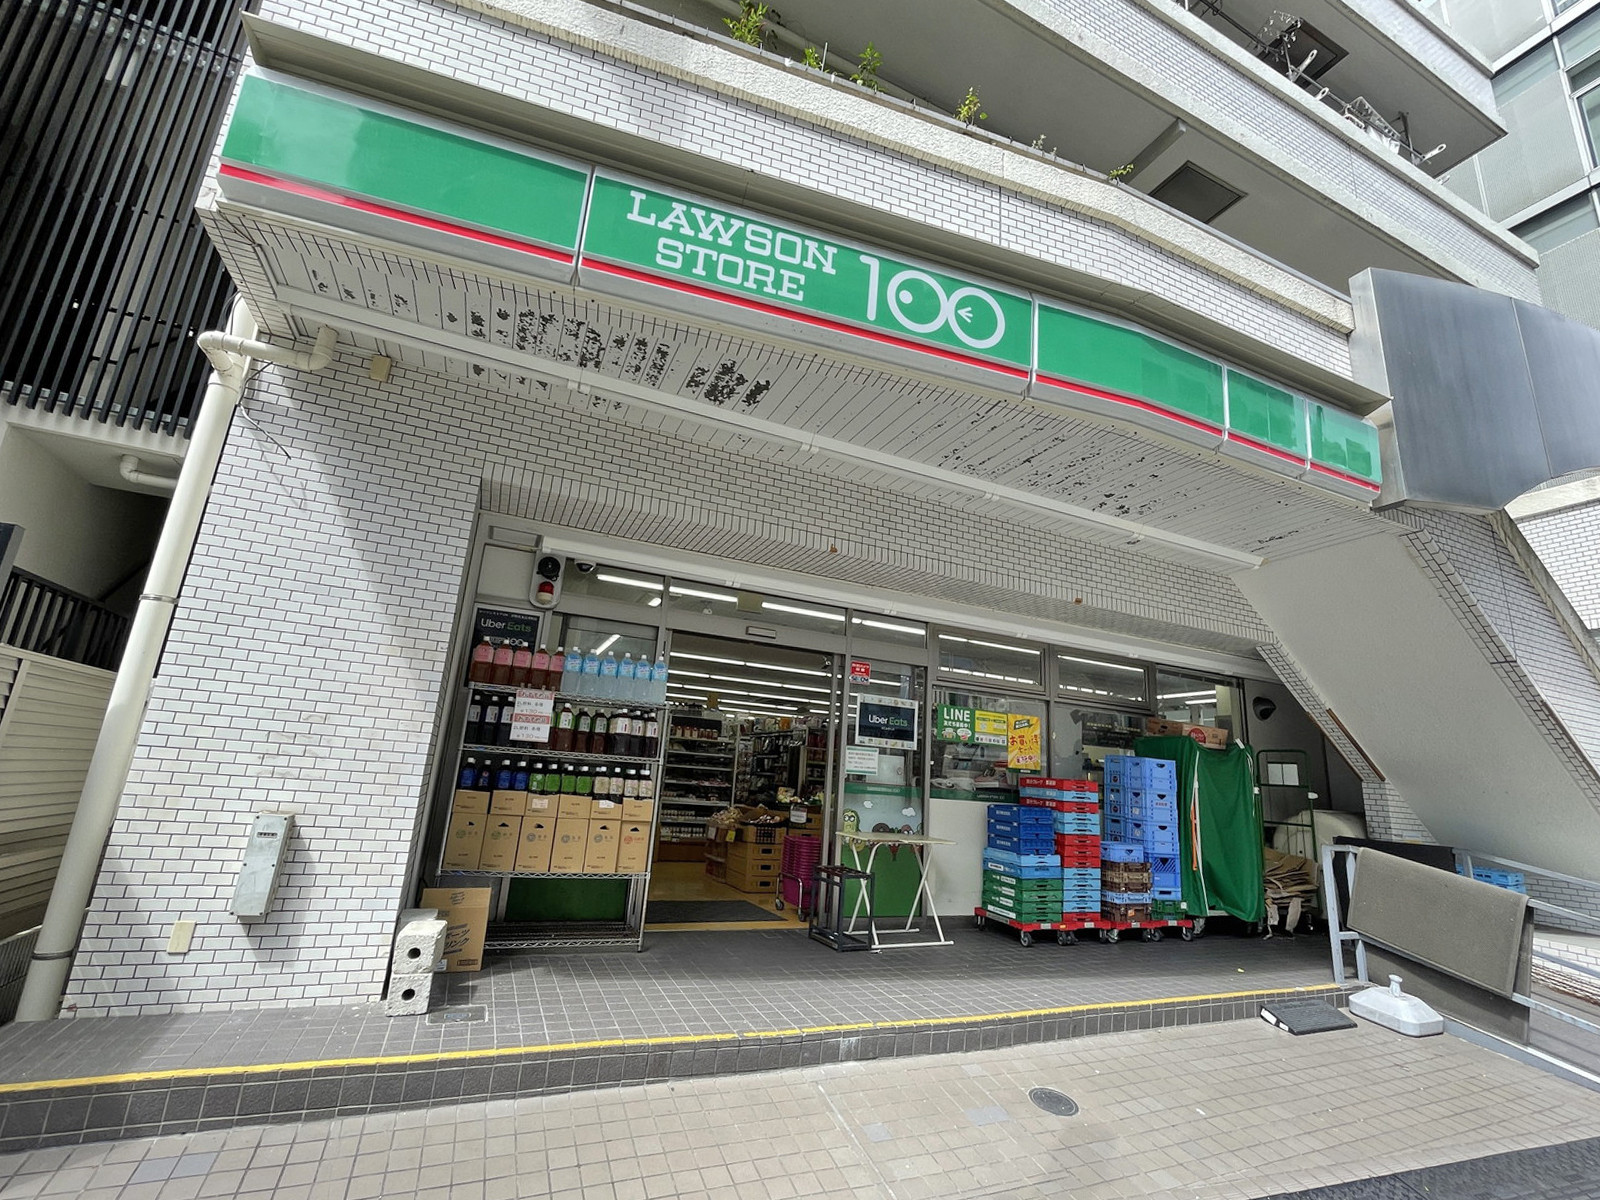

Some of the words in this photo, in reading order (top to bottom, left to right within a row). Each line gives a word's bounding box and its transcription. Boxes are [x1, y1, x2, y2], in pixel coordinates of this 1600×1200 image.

[627, 190, 837, 275] LAWSON
[656, 237, 805, 302] STORE
[860, 254, 1006, 349] 100
[481, 618, 506, 629] Uber
[507, 622, 532, 632] Eats
[868, 714, 888, 724] Uber
[889, 717, 908, 727] Eats
[943, 707, 971, 722] LINE
